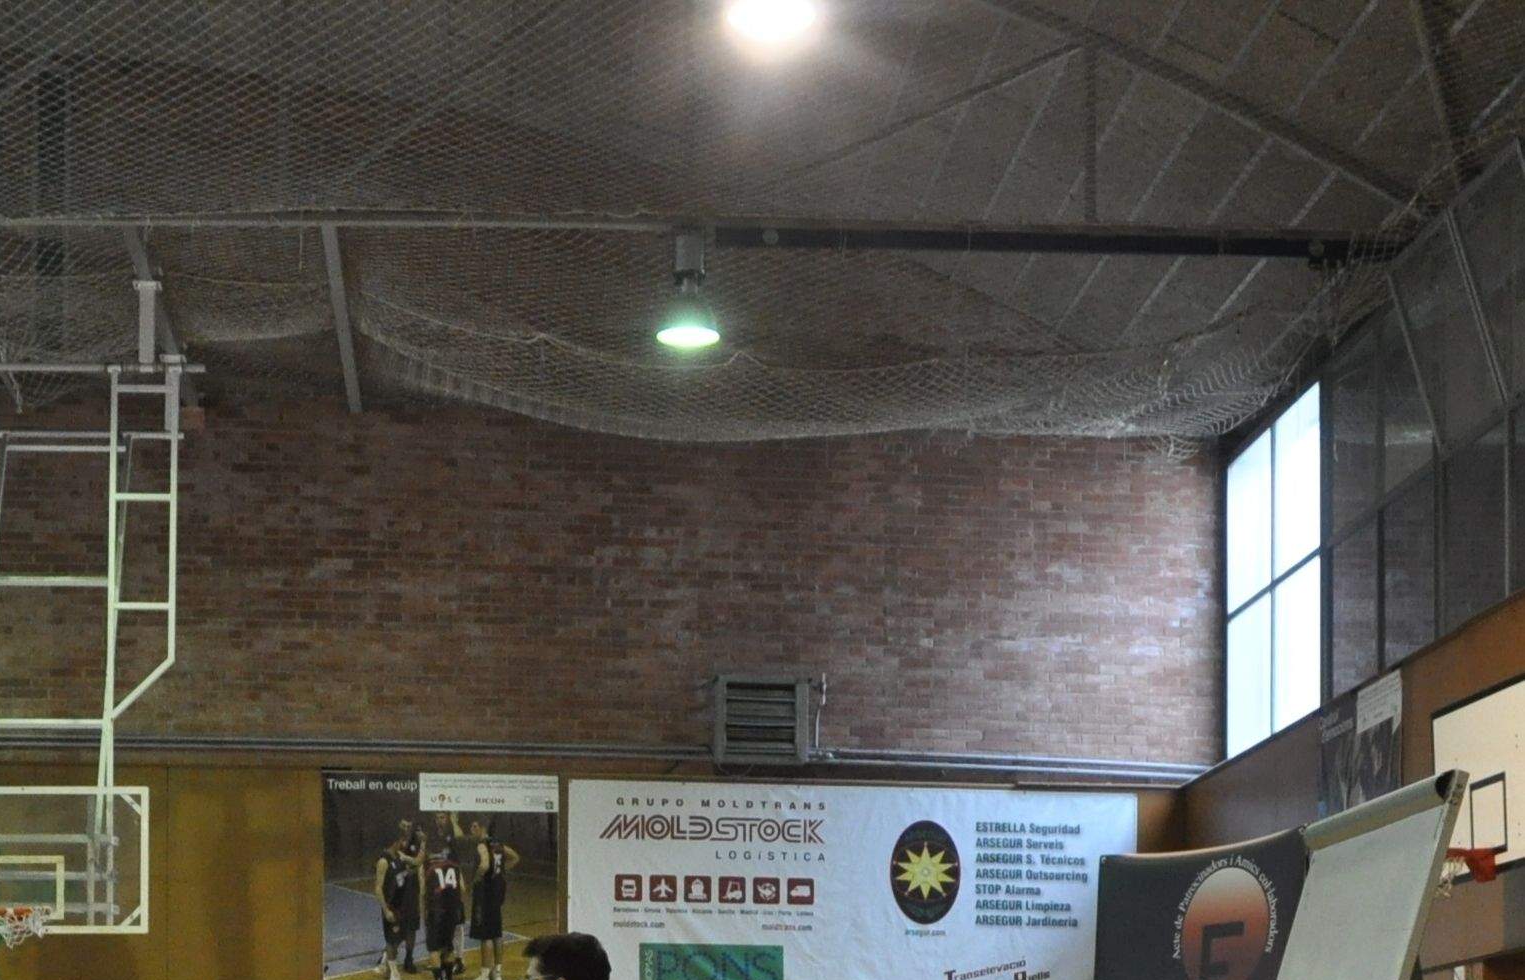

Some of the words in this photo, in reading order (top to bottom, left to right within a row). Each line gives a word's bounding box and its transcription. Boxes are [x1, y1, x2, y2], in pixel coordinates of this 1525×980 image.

[327, 778, 366, 790] Treball
[368, 781, 383, 790] en
[386, 780, 418, 794] equip
[616, 796, 684, 808] GRUPO
[701, 799, 825, 811] MOLDTRANS
[599, 814, 825, 844] MOLDSTOCK
[976, 822, 1026, 833] ESTRELLA
[1029, 823, 1081, 836] Seguridad
[976, 838, 1023, 848] ARSEGUR
[1026, 839, 1064, 850] Serveis
[976, 853, 1023, 864] ARSEGUR
[976, 869, 1023, 880] ARSEGUR
[1026, 869, 1088, 883] Outsourcing
[976, 884, 1002, 895] STOP
[1005, 885, 1041, 896] Alarma
[976, 900, 1023, 910] ARSEGUR
[1026, 900, 1071, 914] Limpieza
[976, 915, 1023, 926] ARSEGUR
